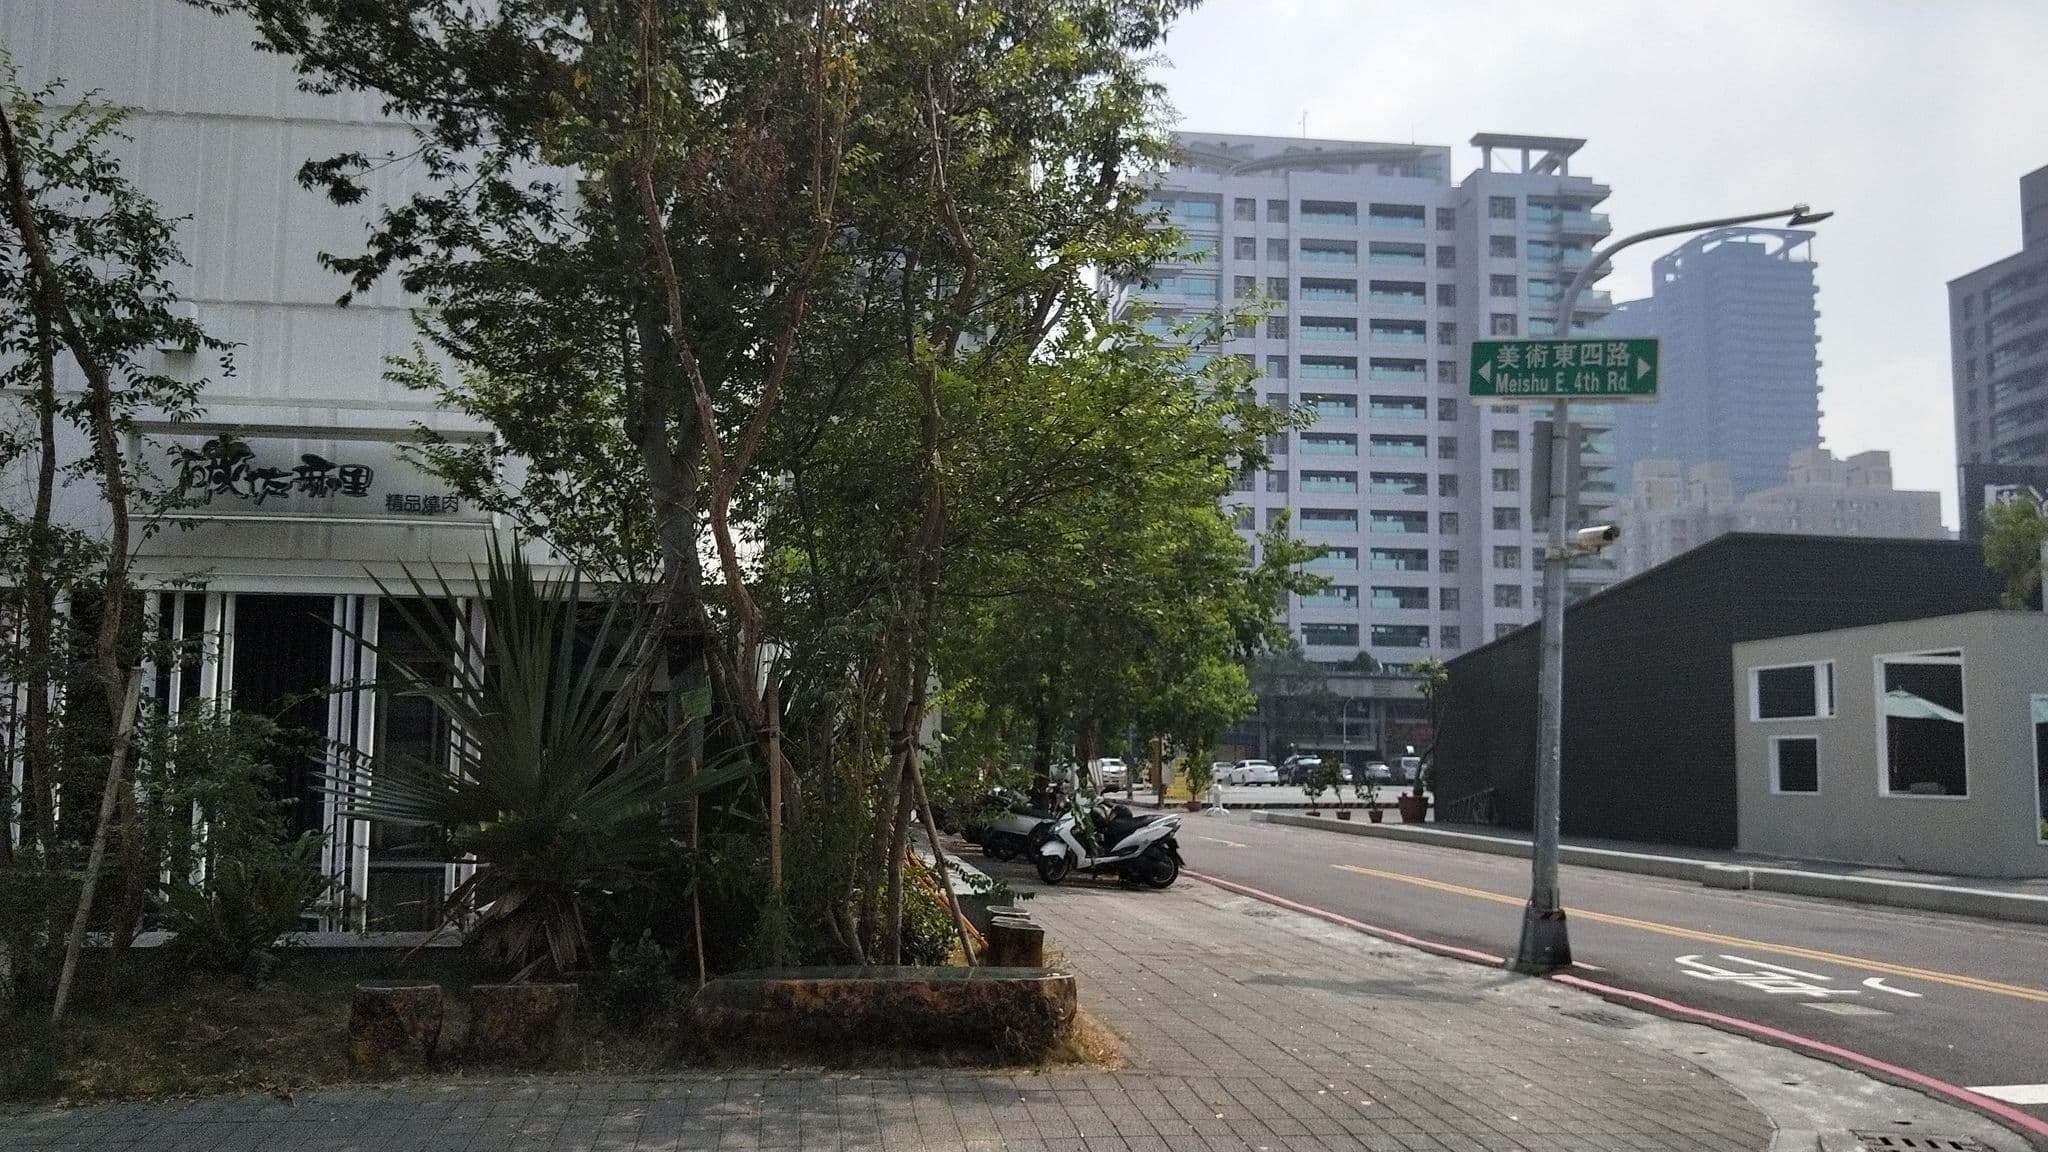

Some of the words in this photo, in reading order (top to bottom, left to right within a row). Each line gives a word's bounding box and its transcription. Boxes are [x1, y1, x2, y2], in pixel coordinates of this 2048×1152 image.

[1497, 343, 1631, 369] 美術東四路
[1495, 373, 1549, 393] Meishu
[1555, 373, 1569, 393] E.
[1574, 372, 1600, 392] 4th
[385, 493, 458, 515] 精品燒肉
